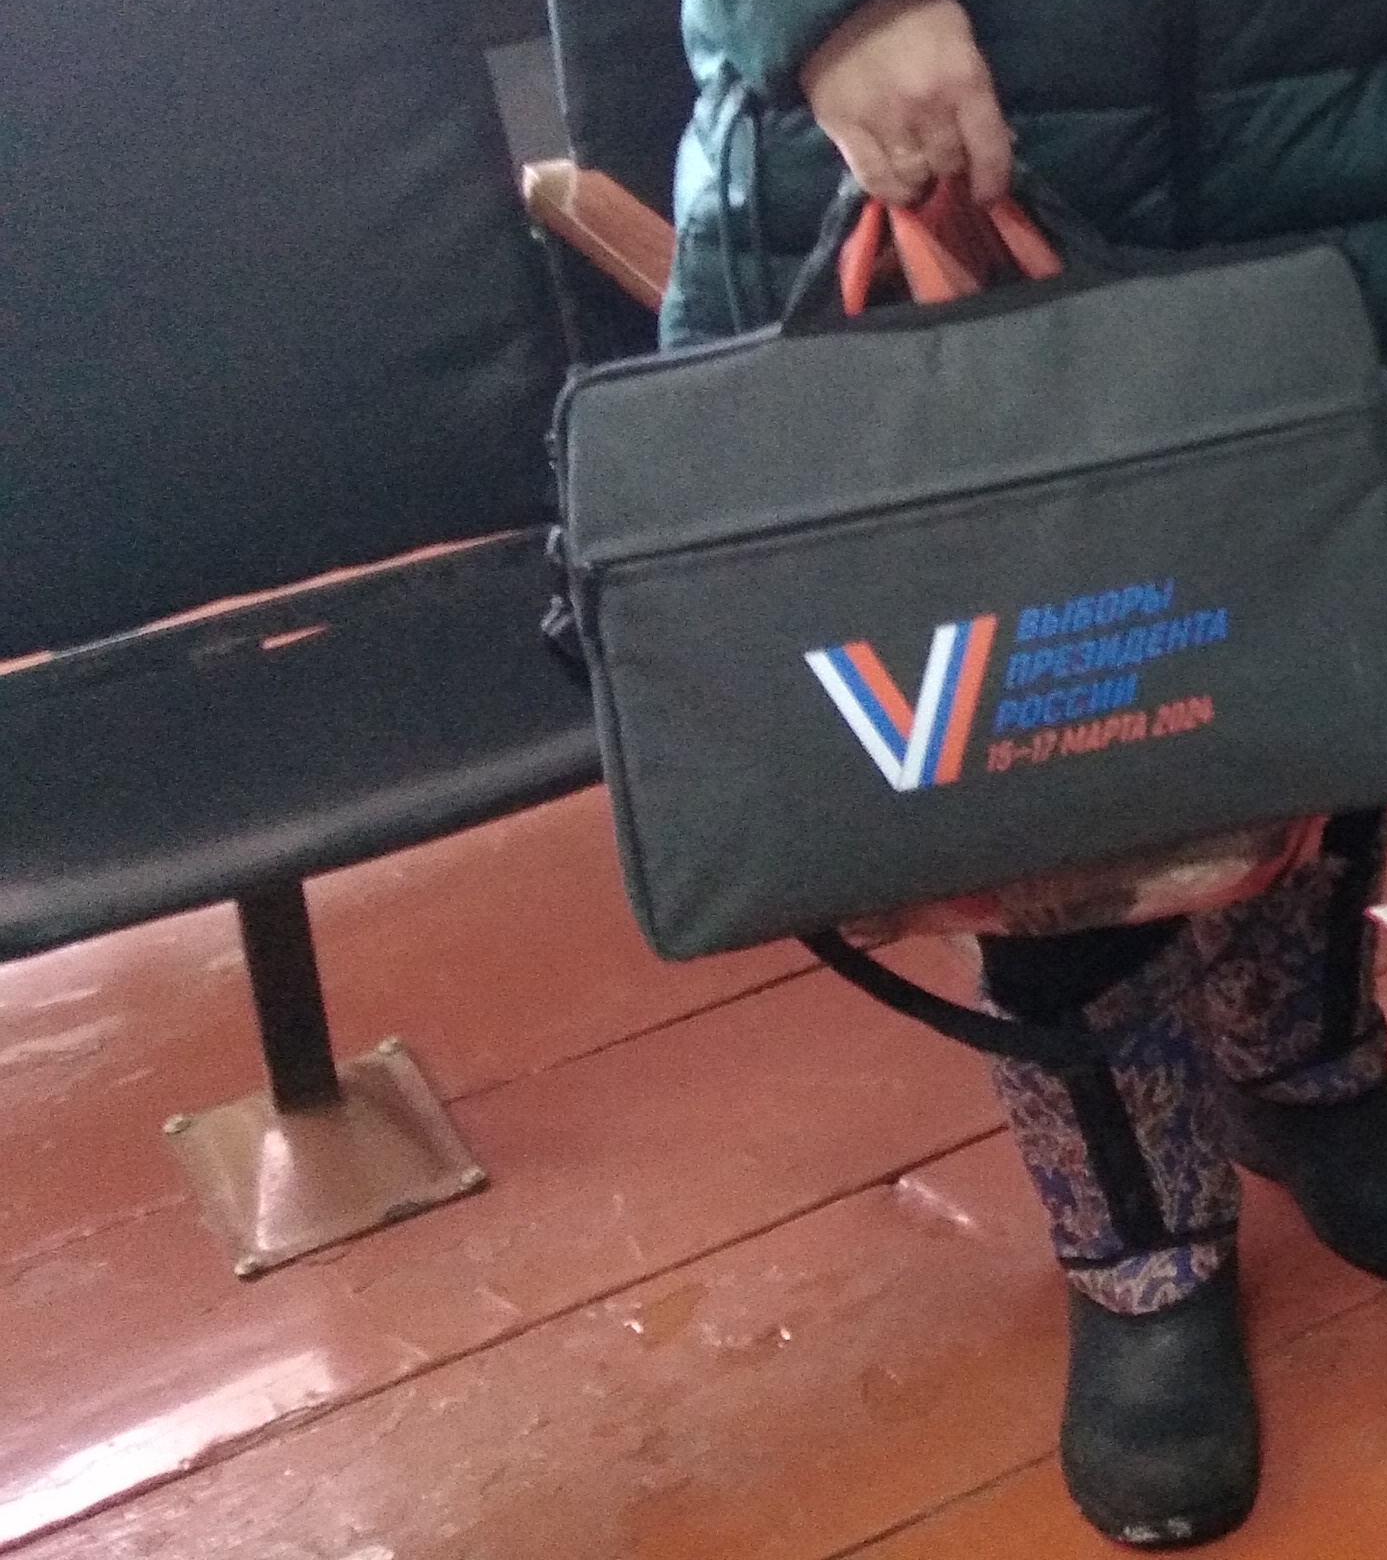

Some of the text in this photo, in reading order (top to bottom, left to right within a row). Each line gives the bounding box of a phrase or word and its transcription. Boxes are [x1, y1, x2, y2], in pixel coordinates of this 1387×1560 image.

[1015, 578, 1175, 642] ВЫБОРЫ
[1006, 607, 1229, 689] ПРЕЗИДЕНТА
[994, 673, 1139, 734] РОССИИ
[1060, 711, 1148, 756] МАРТА
[1151, 695, 1214, 737] 2024
